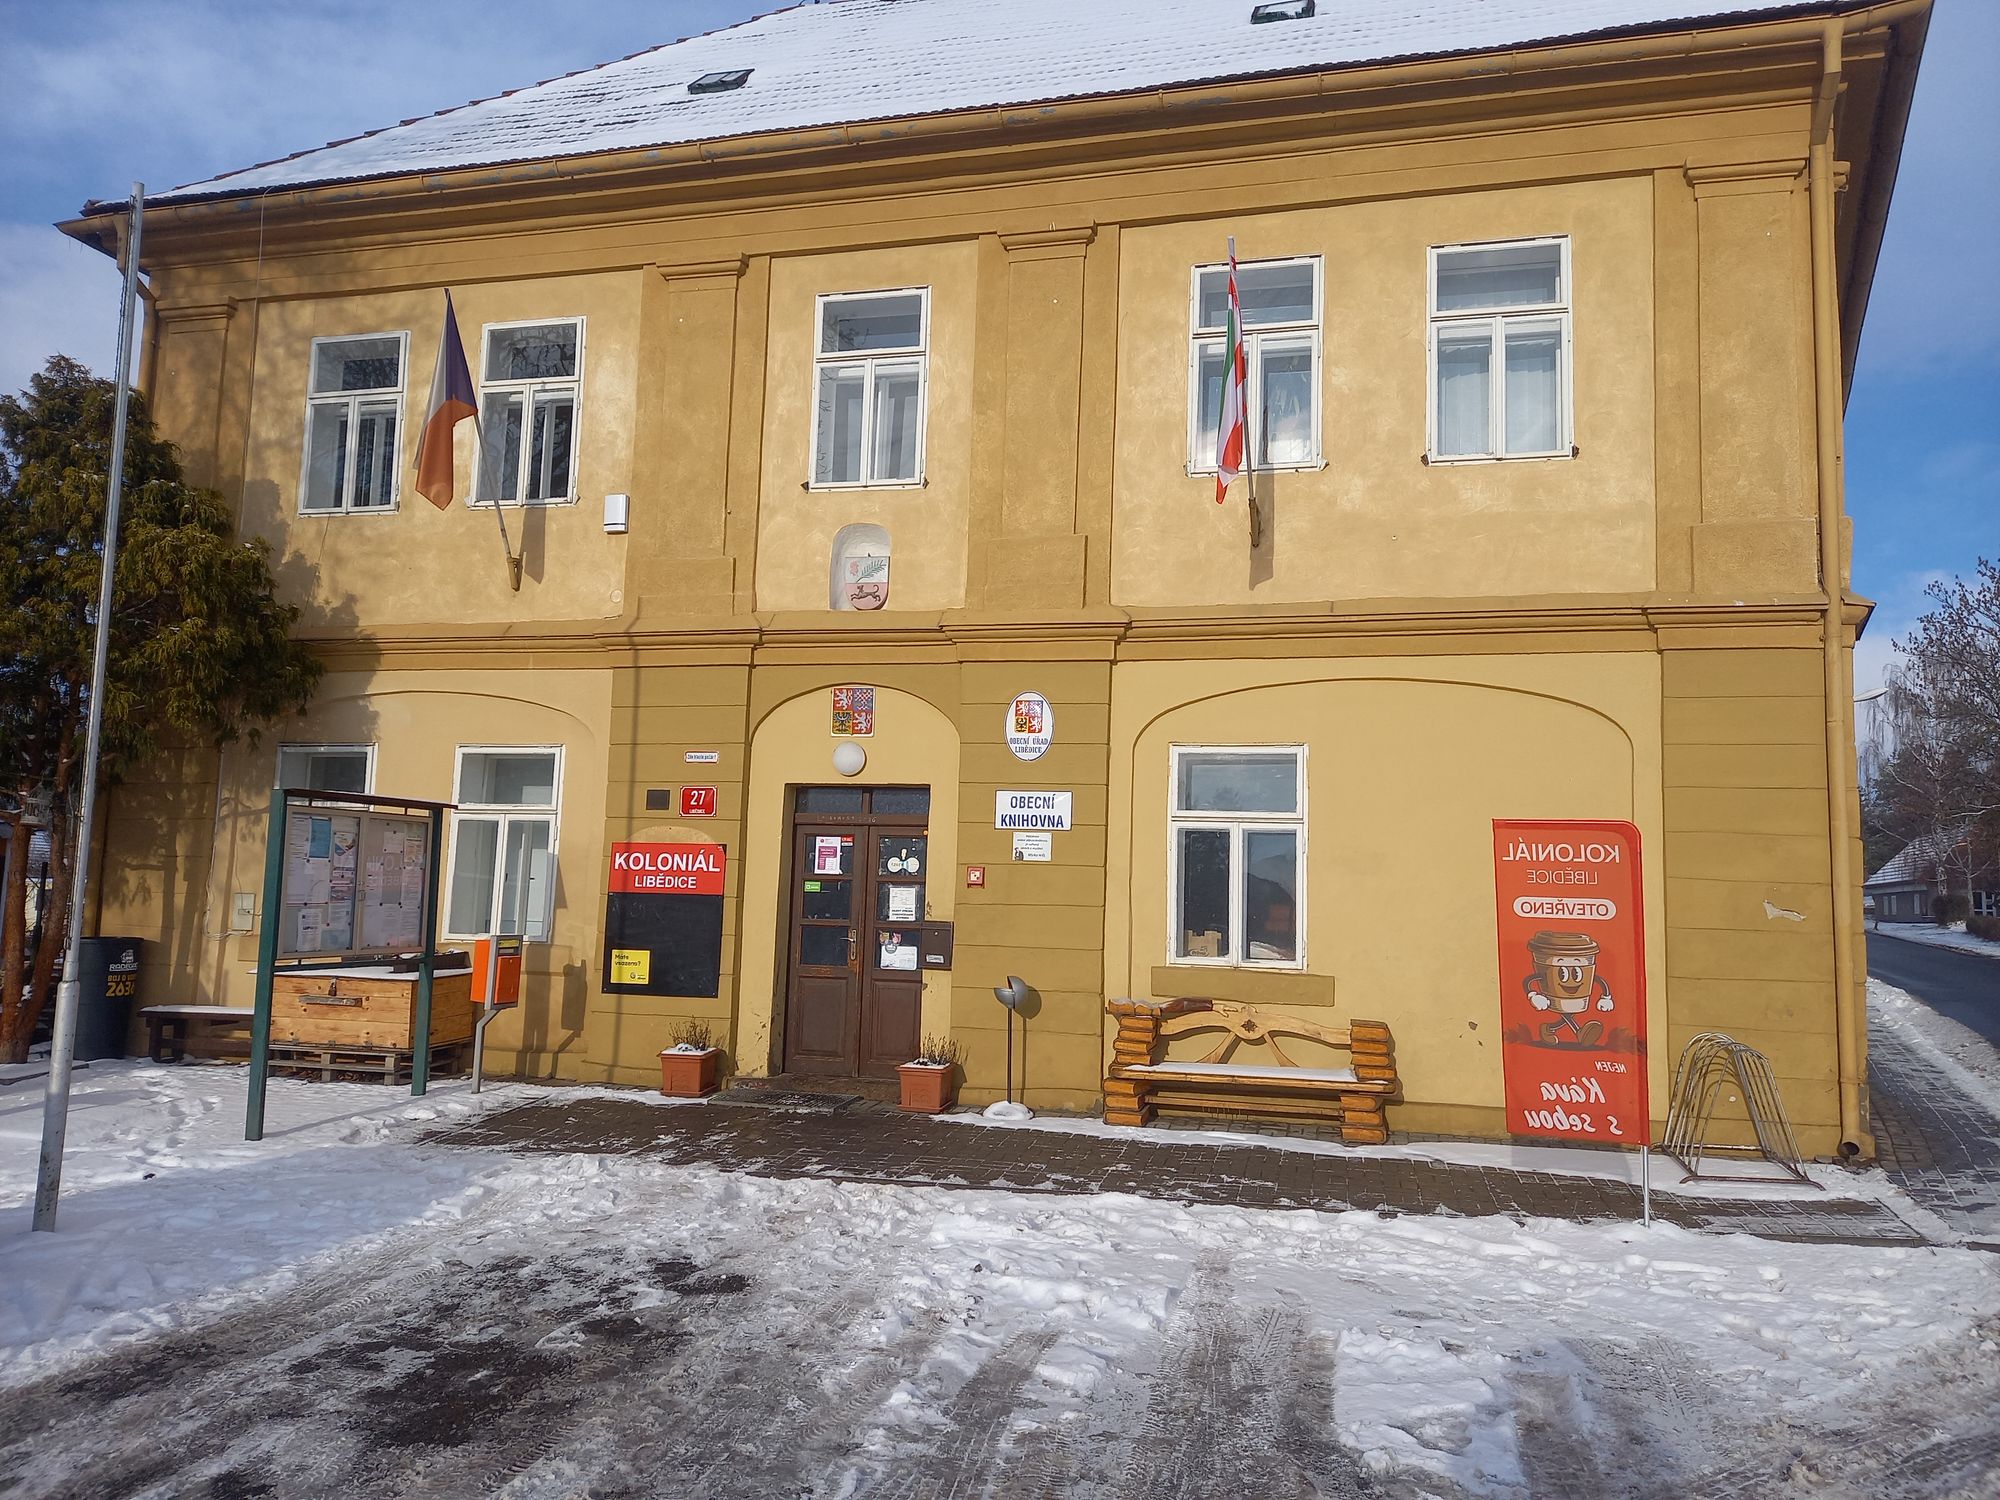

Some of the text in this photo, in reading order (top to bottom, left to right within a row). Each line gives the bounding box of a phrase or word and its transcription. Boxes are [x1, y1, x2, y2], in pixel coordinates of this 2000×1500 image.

[1009, 736, 1049, 745] OBECNÍ ÚŘAD
[1014, 745, 1042, 753] LIBĚDICE
[690, 790, 706, 805] 27
[1010, 793, 1056, 809] OBECNÍ
[1000, 814, 1064, 828] KNIHOVNA
[614, 849, 721, 872] KOLONIÁL
[634, 873, 697, 889] LIBĚDICE
